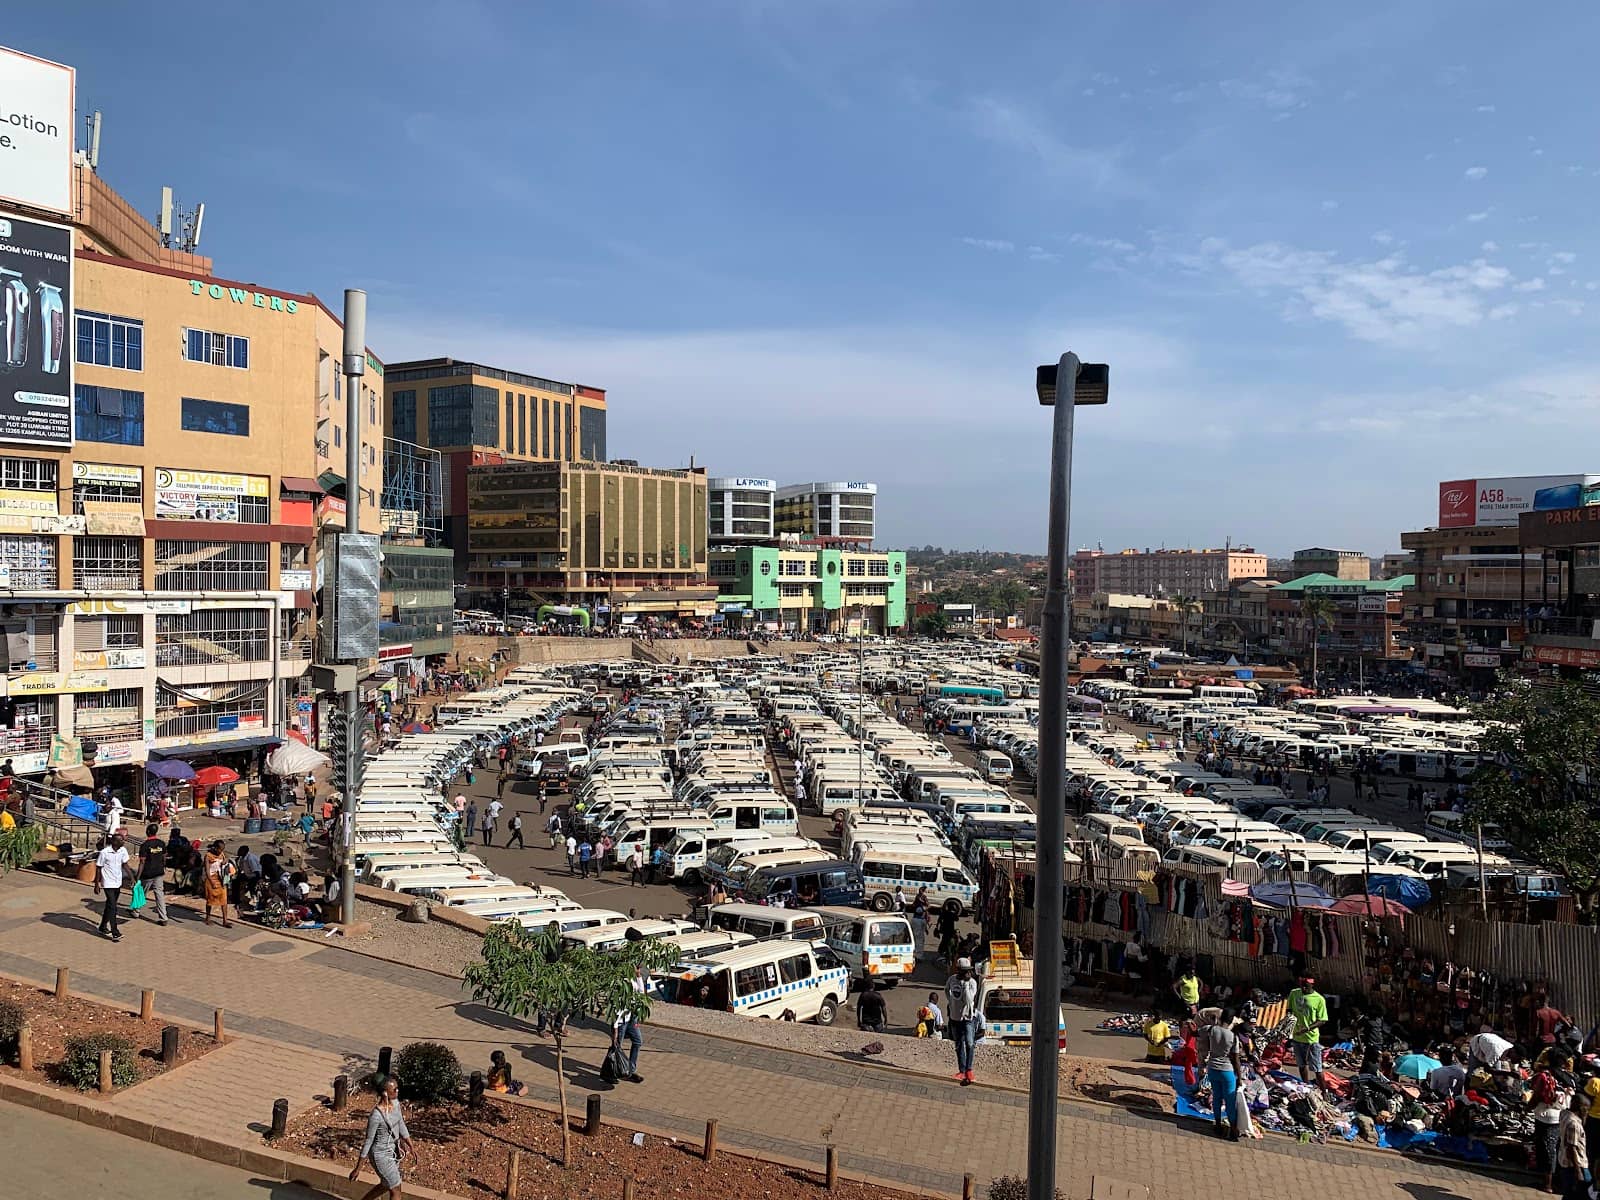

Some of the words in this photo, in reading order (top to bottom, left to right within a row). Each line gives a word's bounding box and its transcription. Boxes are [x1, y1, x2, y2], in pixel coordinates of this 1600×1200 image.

[22, 247, 43, 258] WITH
[44, 251, 69, 263] WAHL
[189, 279, 299, 314] TOWERS
[88, 464, 138, 475] DIVINE
[569, 462, 597, 471] ROYAL
[600, 463, 629, 473] COMPLEX
[630, 466, 650, 475] HOTEL
[175, 471, 244, 486] DIVINE
[847, 481, 869, 490] HOTEL
[160, 491, 196, 501] VICTORY
[1479, 488, 1504, 503] A58
[1545, 509, 1582, 525] PARK
[22, 682, 56, 690] TRADERS
